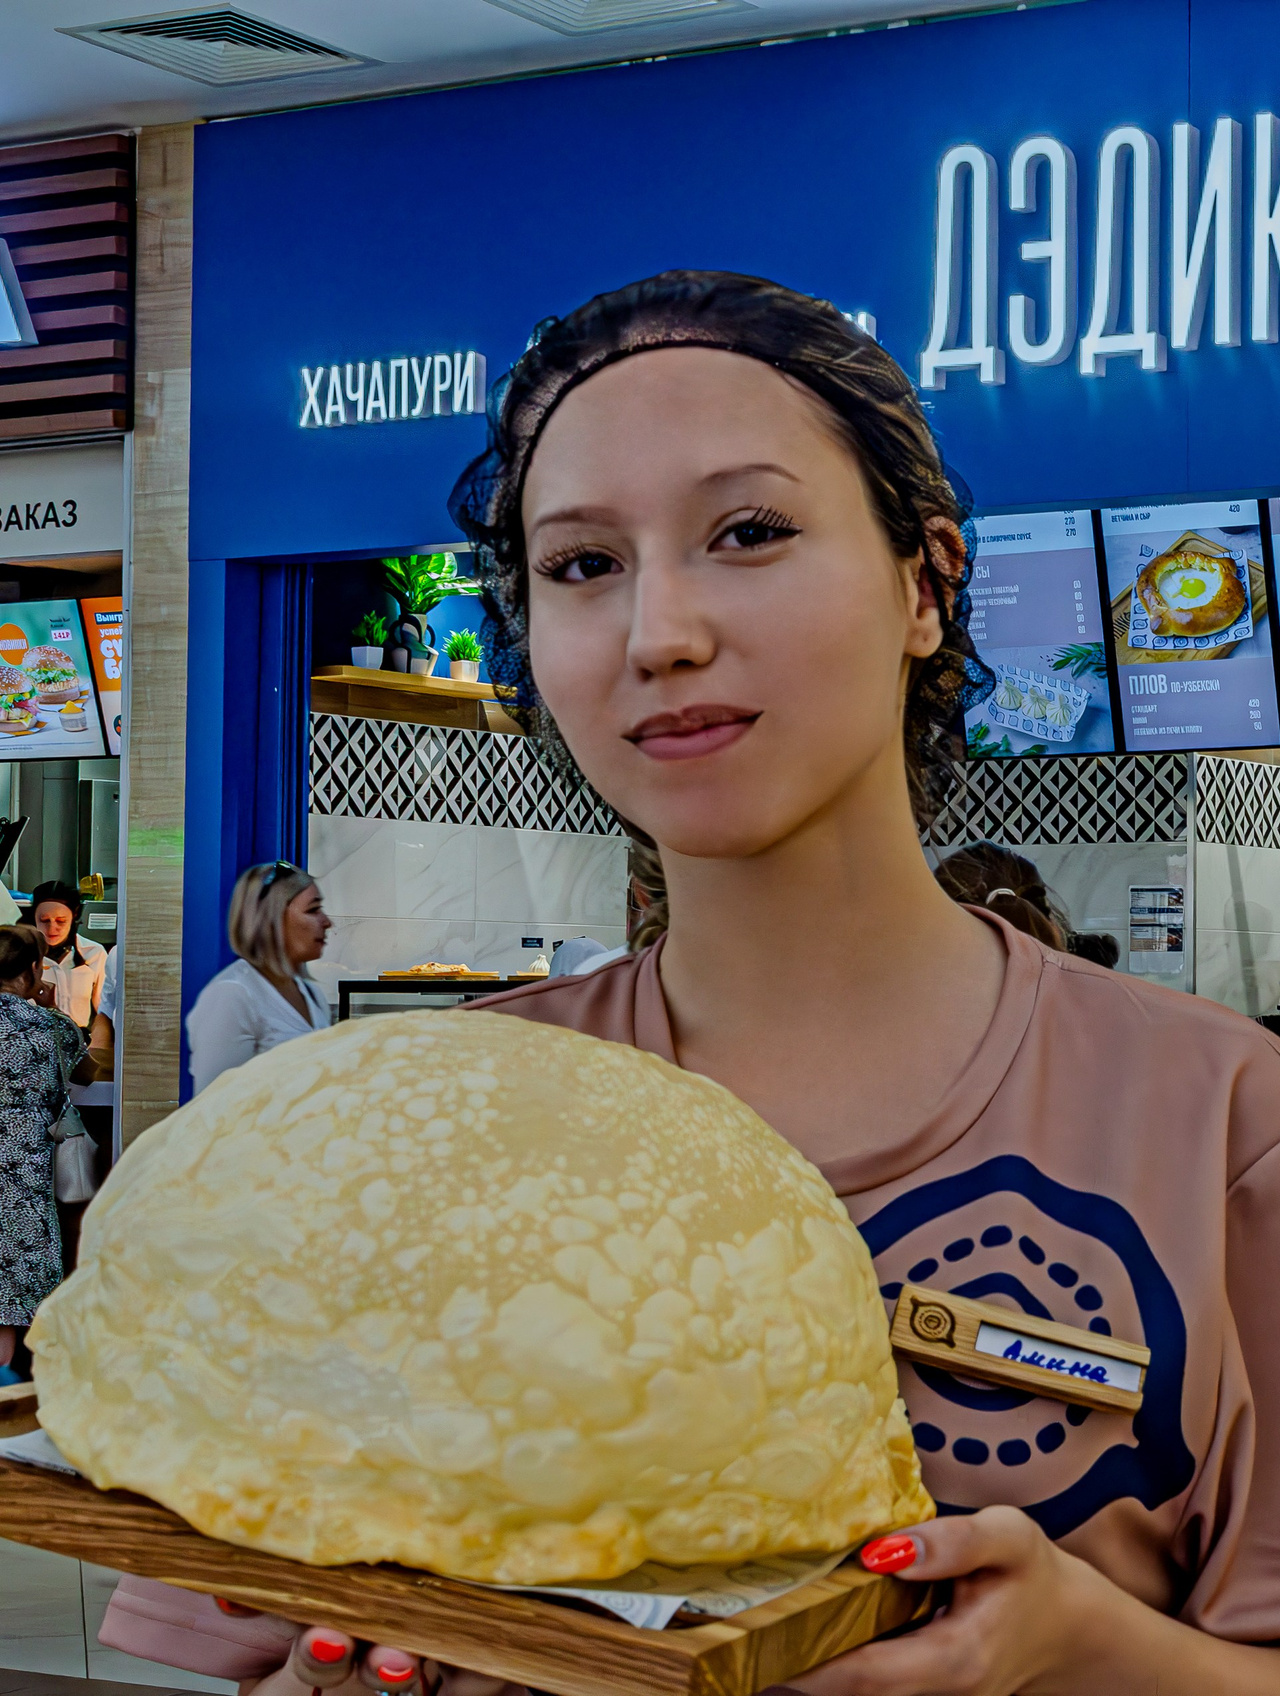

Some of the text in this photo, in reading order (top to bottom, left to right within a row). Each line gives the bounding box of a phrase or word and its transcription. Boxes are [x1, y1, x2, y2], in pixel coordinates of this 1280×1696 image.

[299, 350, 486, 427] ХАЧАПУРИ
[0, 499, 78, 532] АКАЗ
[1128, 674, 1220, 695] ПЛОВ ПО-УЗБЕКСКИ
[1002, 1339, 1110, 1384] Амина
